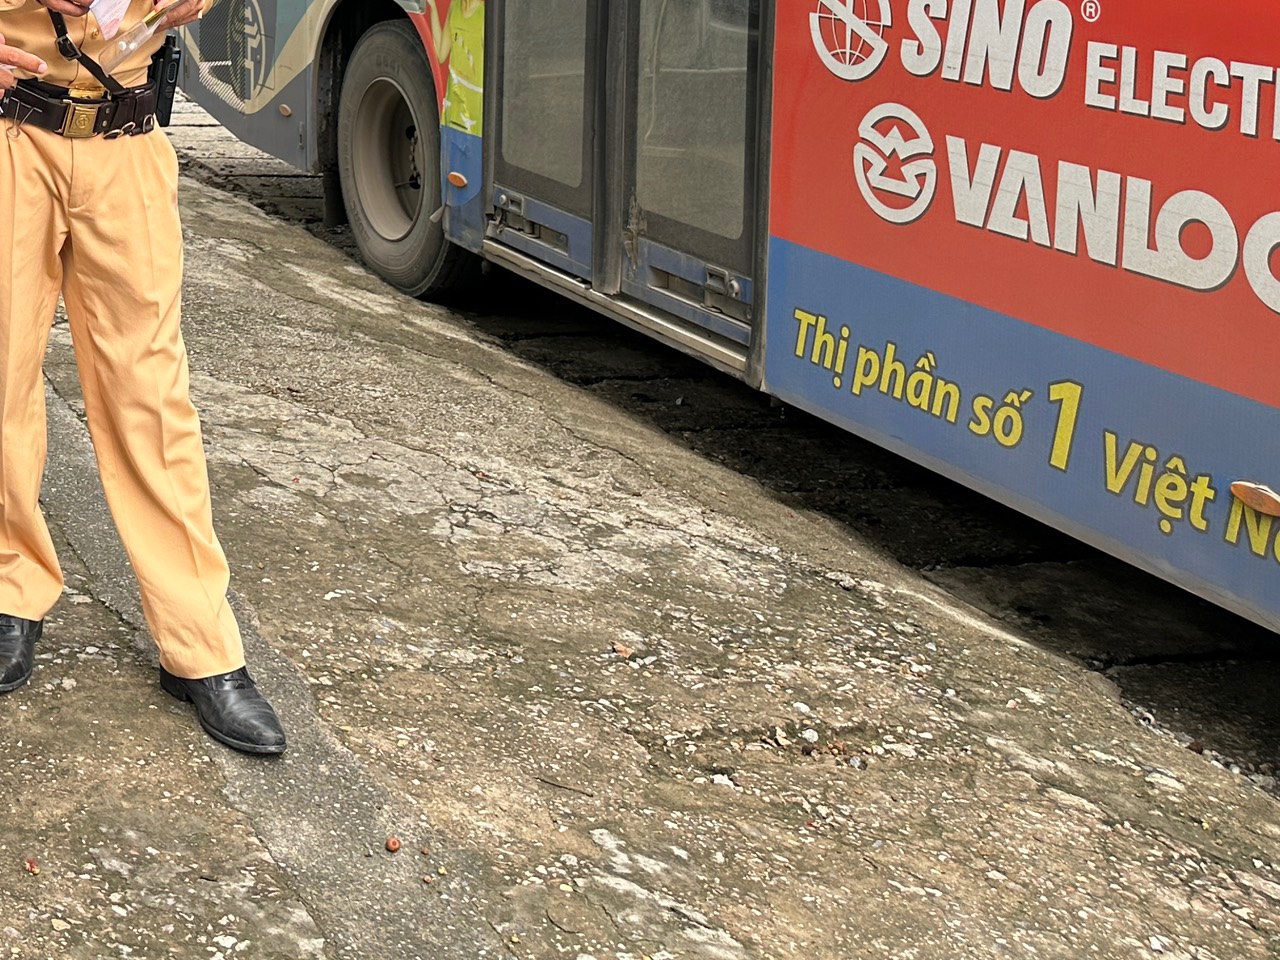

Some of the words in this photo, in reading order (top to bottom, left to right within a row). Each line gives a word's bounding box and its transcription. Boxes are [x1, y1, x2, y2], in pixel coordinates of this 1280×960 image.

[1084, 40, 1280, 141] ELECT
[793, 307, 851, 388] Thị
[851, 342, 961, 424] phần
[968, 389, 1033, 447] số
[1048, 380, 1084, 472] 1
[1104, 430, 1215, 533] Việt
